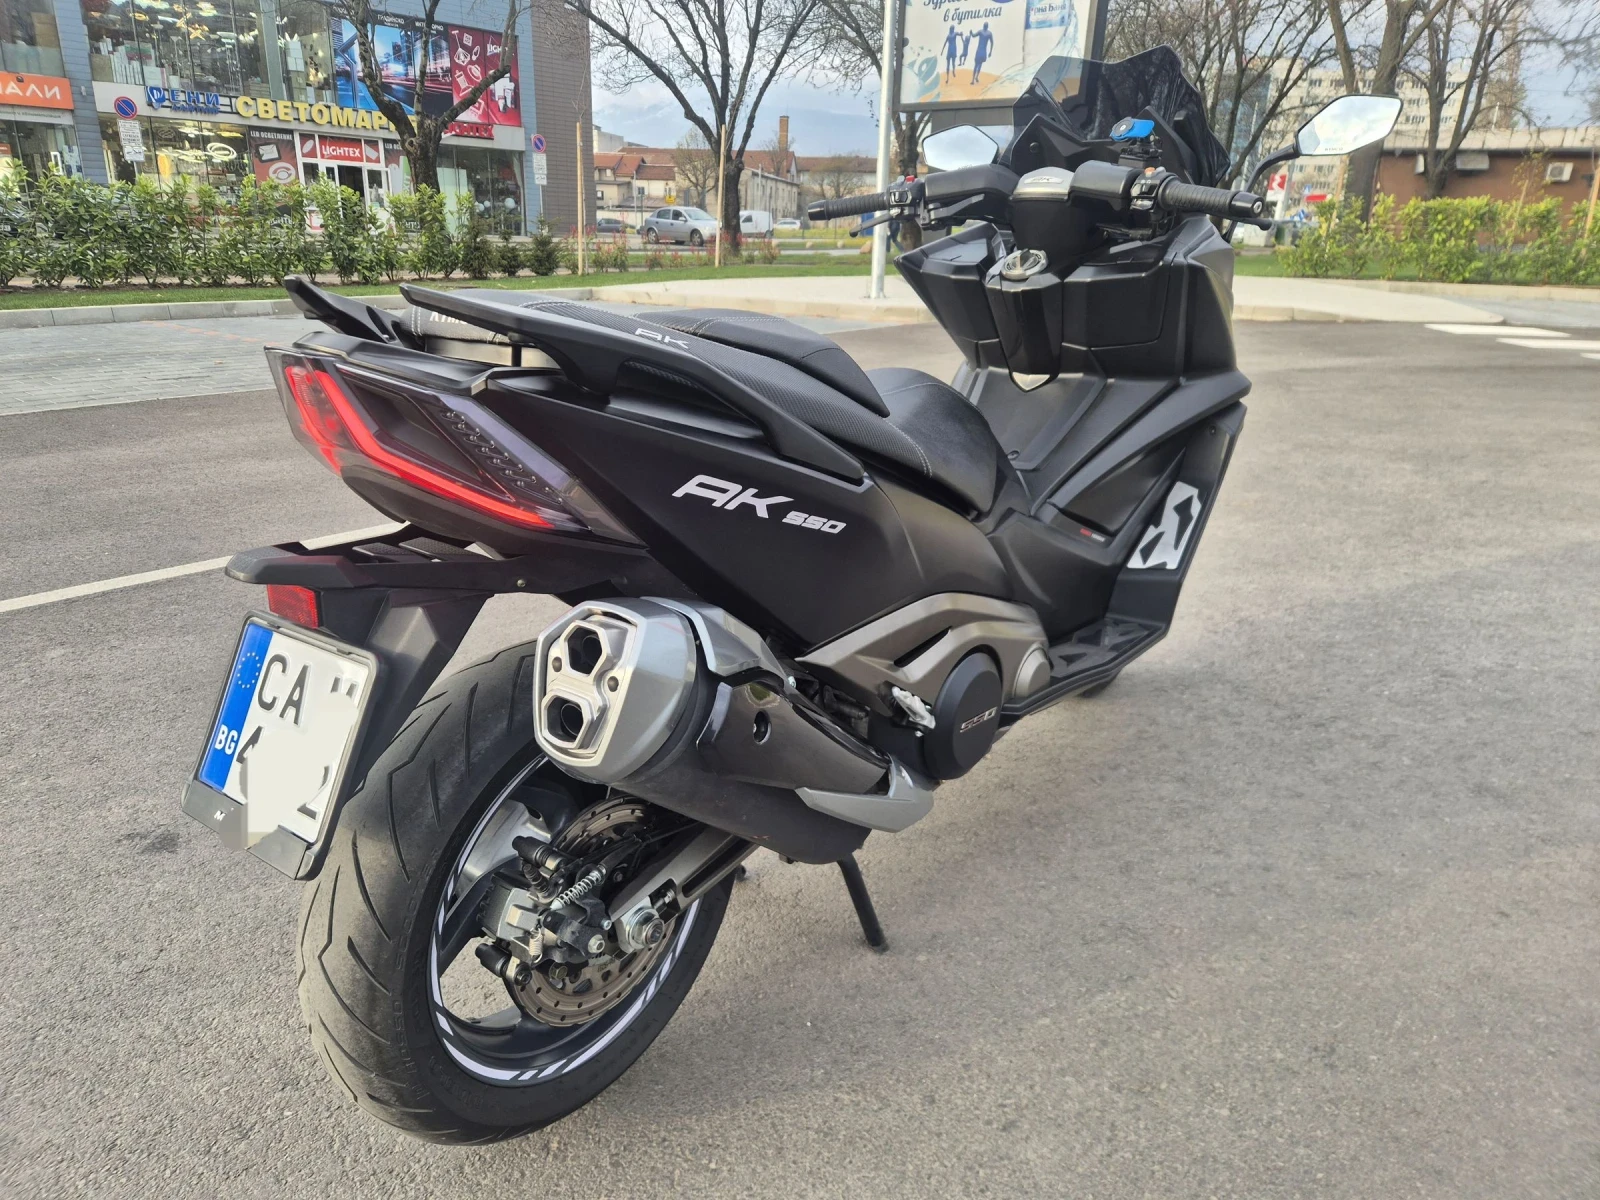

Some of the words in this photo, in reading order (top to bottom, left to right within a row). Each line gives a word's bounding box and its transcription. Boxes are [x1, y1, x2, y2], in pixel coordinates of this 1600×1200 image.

[952, 6, 1002, 25] бутилка
[0, 81, 60, 100] АЛИ
[236, 95, 418, 133] СВЕТОМАР
[322, 145, 361, 158] LIGHTEX
[635, 327, 689, 349] AK
[672, 474, 795, 519] AK
[782, 510, 847, 534] 550
[257, 653, 310, 726] CA
[960, 706, 997, 733] 550
[214, 724, 238, 755] BG
